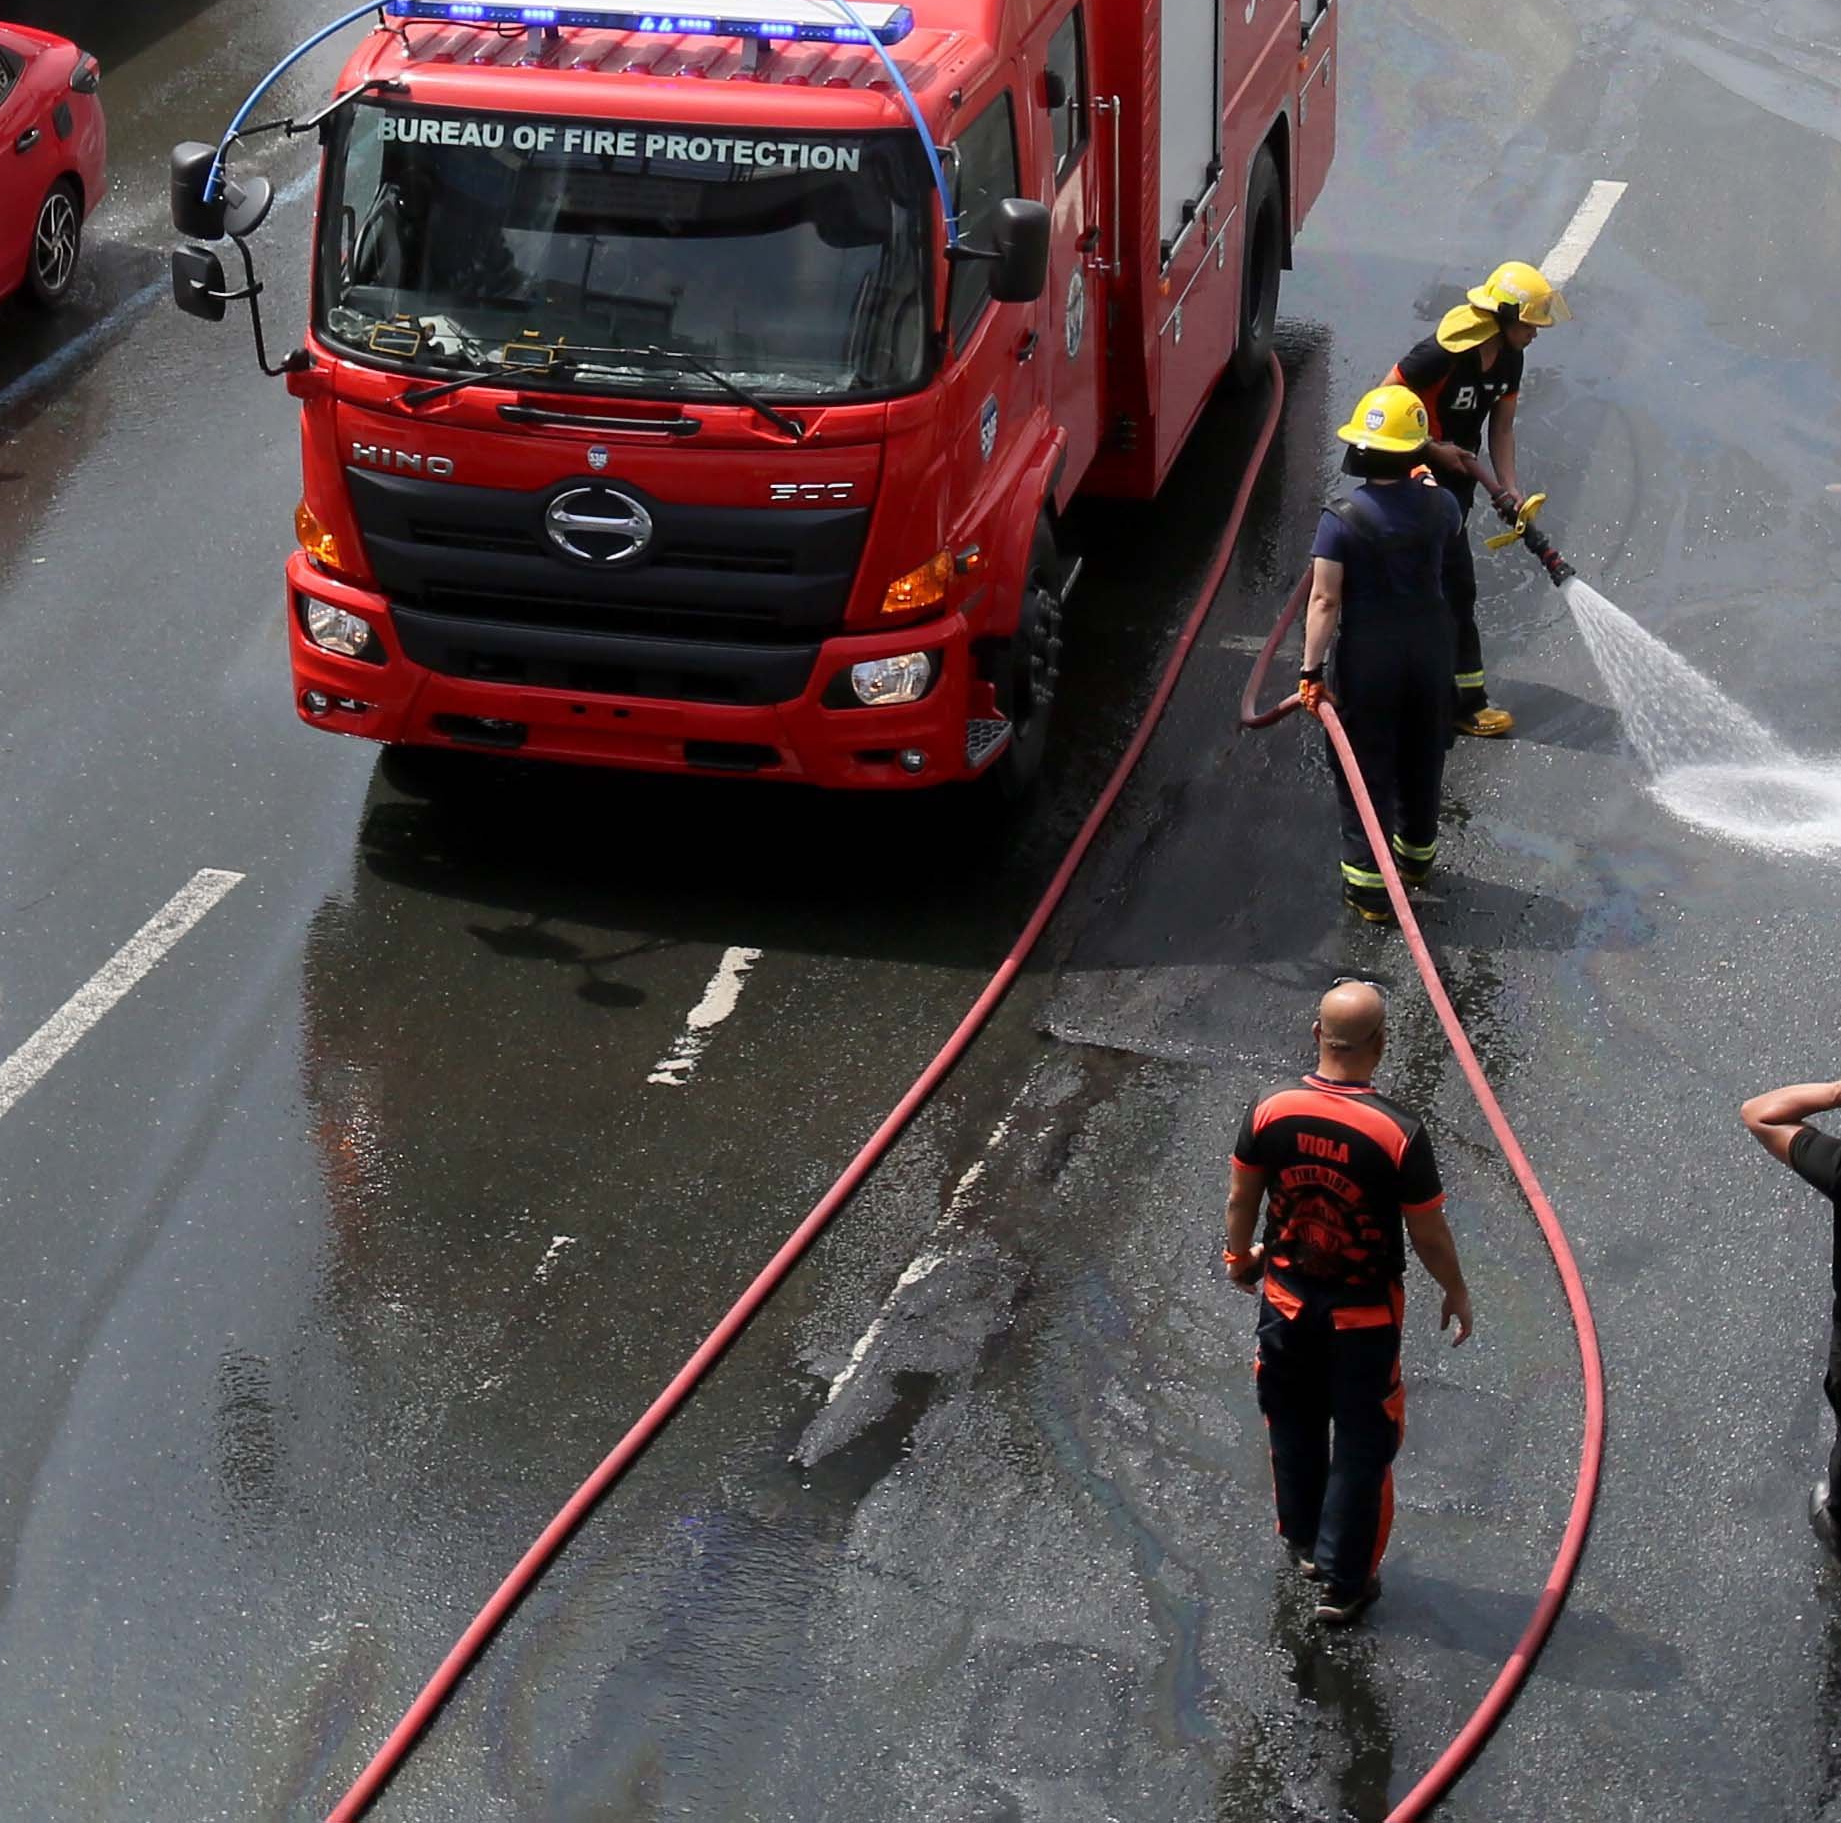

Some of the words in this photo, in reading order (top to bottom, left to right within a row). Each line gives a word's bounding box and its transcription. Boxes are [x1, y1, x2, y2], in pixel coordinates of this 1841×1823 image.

[376, 116, 504, 150] BUREAU
[511, 126, 556, 151] OF
[563, 127, 639, 159] FIRE
[645, 134, 861, 174] PROTECTION
[352, 443, 454, 477] HINO
[1296, 1132, 1350, 1164] VIOLA
